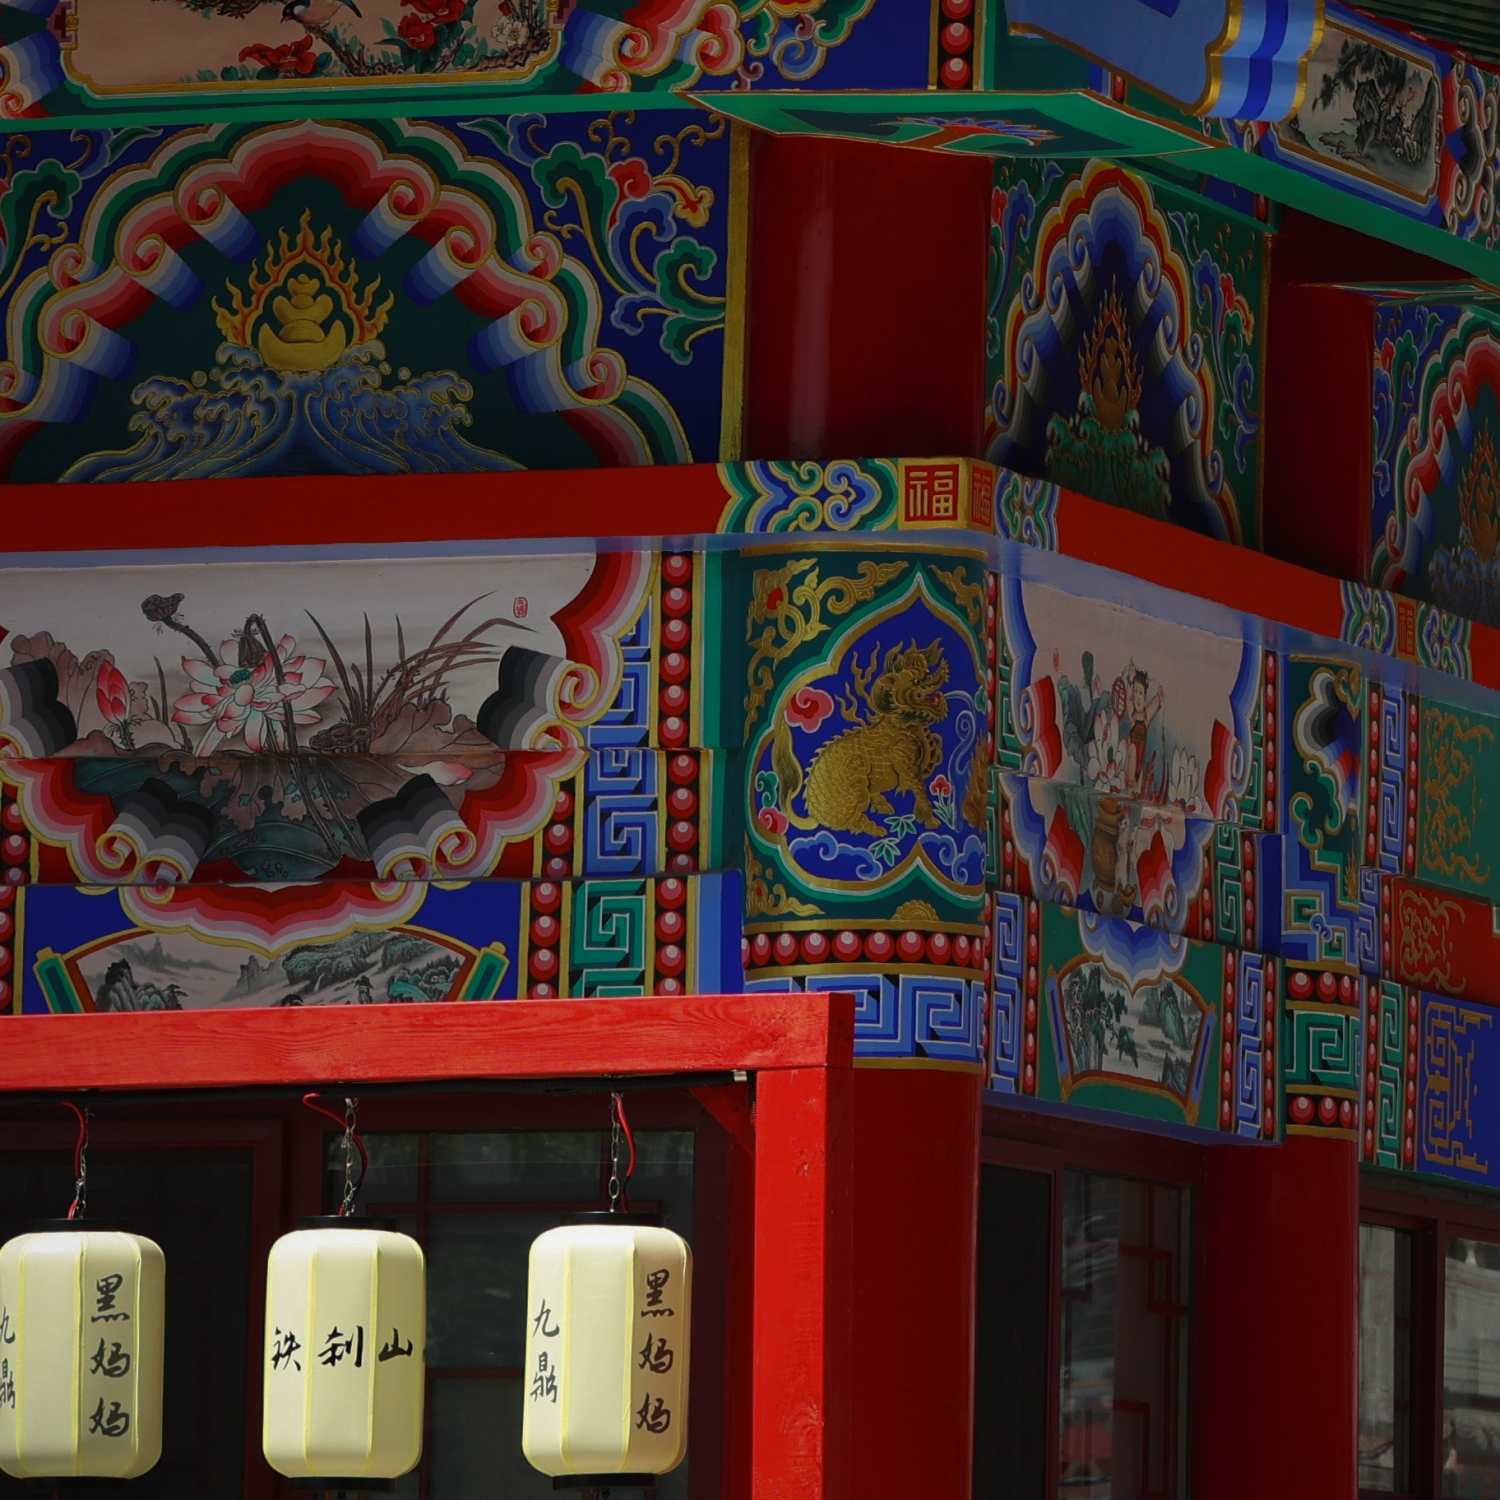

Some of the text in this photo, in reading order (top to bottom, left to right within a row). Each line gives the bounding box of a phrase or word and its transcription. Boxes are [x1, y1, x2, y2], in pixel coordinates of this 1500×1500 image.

[908, 470, 955, 519] 福
[972, 470, 992, 524] 福
[1397, 606, 1414, 653] 福
[89, 1273, 131, 1437] 黑妈妈
[271, 1325, 413, 1372] 铁刹山
[530, 1297, 560, 1404] 九鼎
[636, 1268, 675, 1435] 黑妈妈
